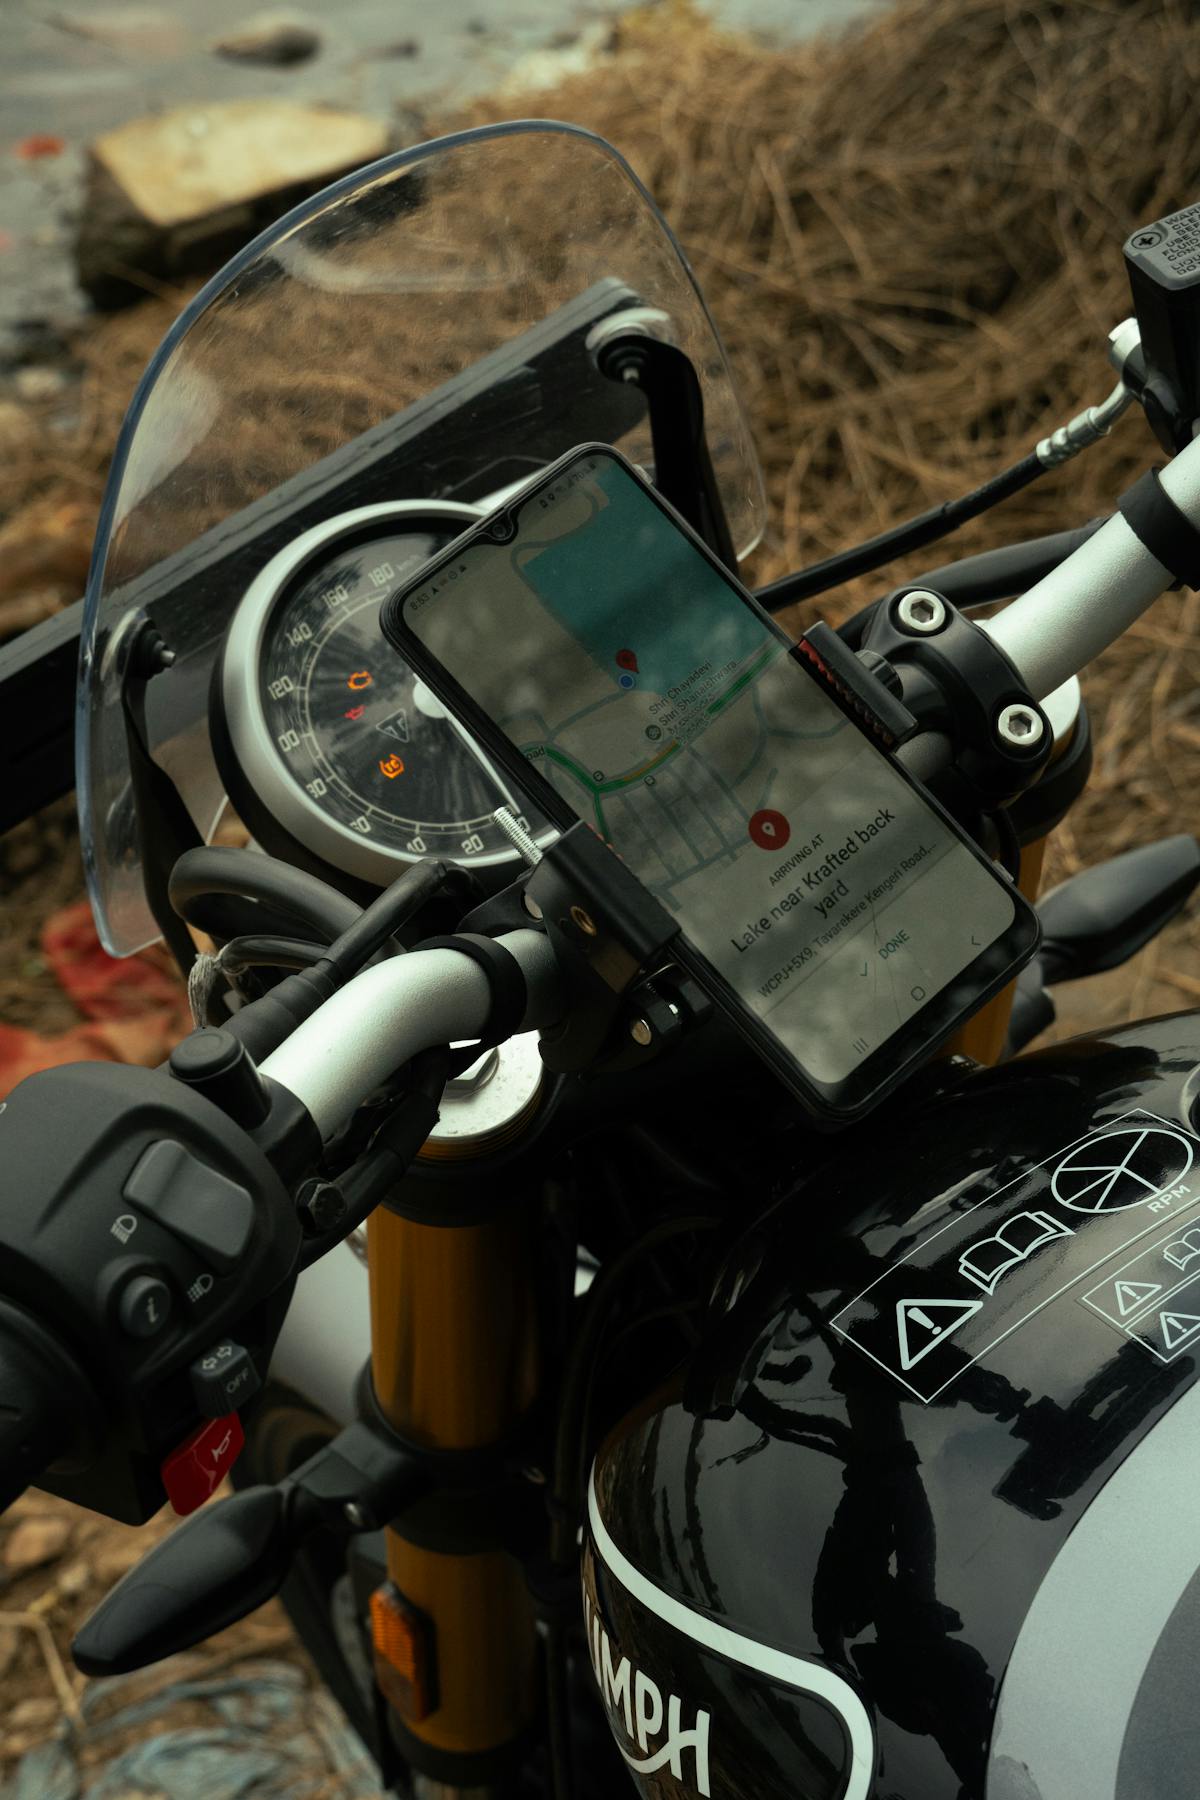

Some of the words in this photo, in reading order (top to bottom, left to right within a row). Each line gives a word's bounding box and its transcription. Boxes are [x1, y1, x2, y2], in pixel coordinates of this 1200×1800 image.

[1172, 213, 1200, 230] CLE
[368, 562, 395, 587] 180
[321, 584, 349, 609] 160
[286, 622, 313, 647] 140
[268, 674, 294, 700] 120
[649, 695, 670, 715] Shri
[658, 707, 680, 727] Shri
[461, 834, 485, 856] 20
[769, 844, 813, 887] ARRIVING
[810, 834, 825, 851] AT
[731, 916, 772, 953] Lake
[770, 886, 805, 922] near
[802, 837, 860, 891] Krafted
[854, 808, 896, 844] back
[814, 879, 850, 919] yard
[814, 900, 867, 948] Tavarekere
[878, 929, 910, 960] DONE
[1147, 1184, 1192, 1213] RPM
[225, 1368, 250, 1394] OFF
